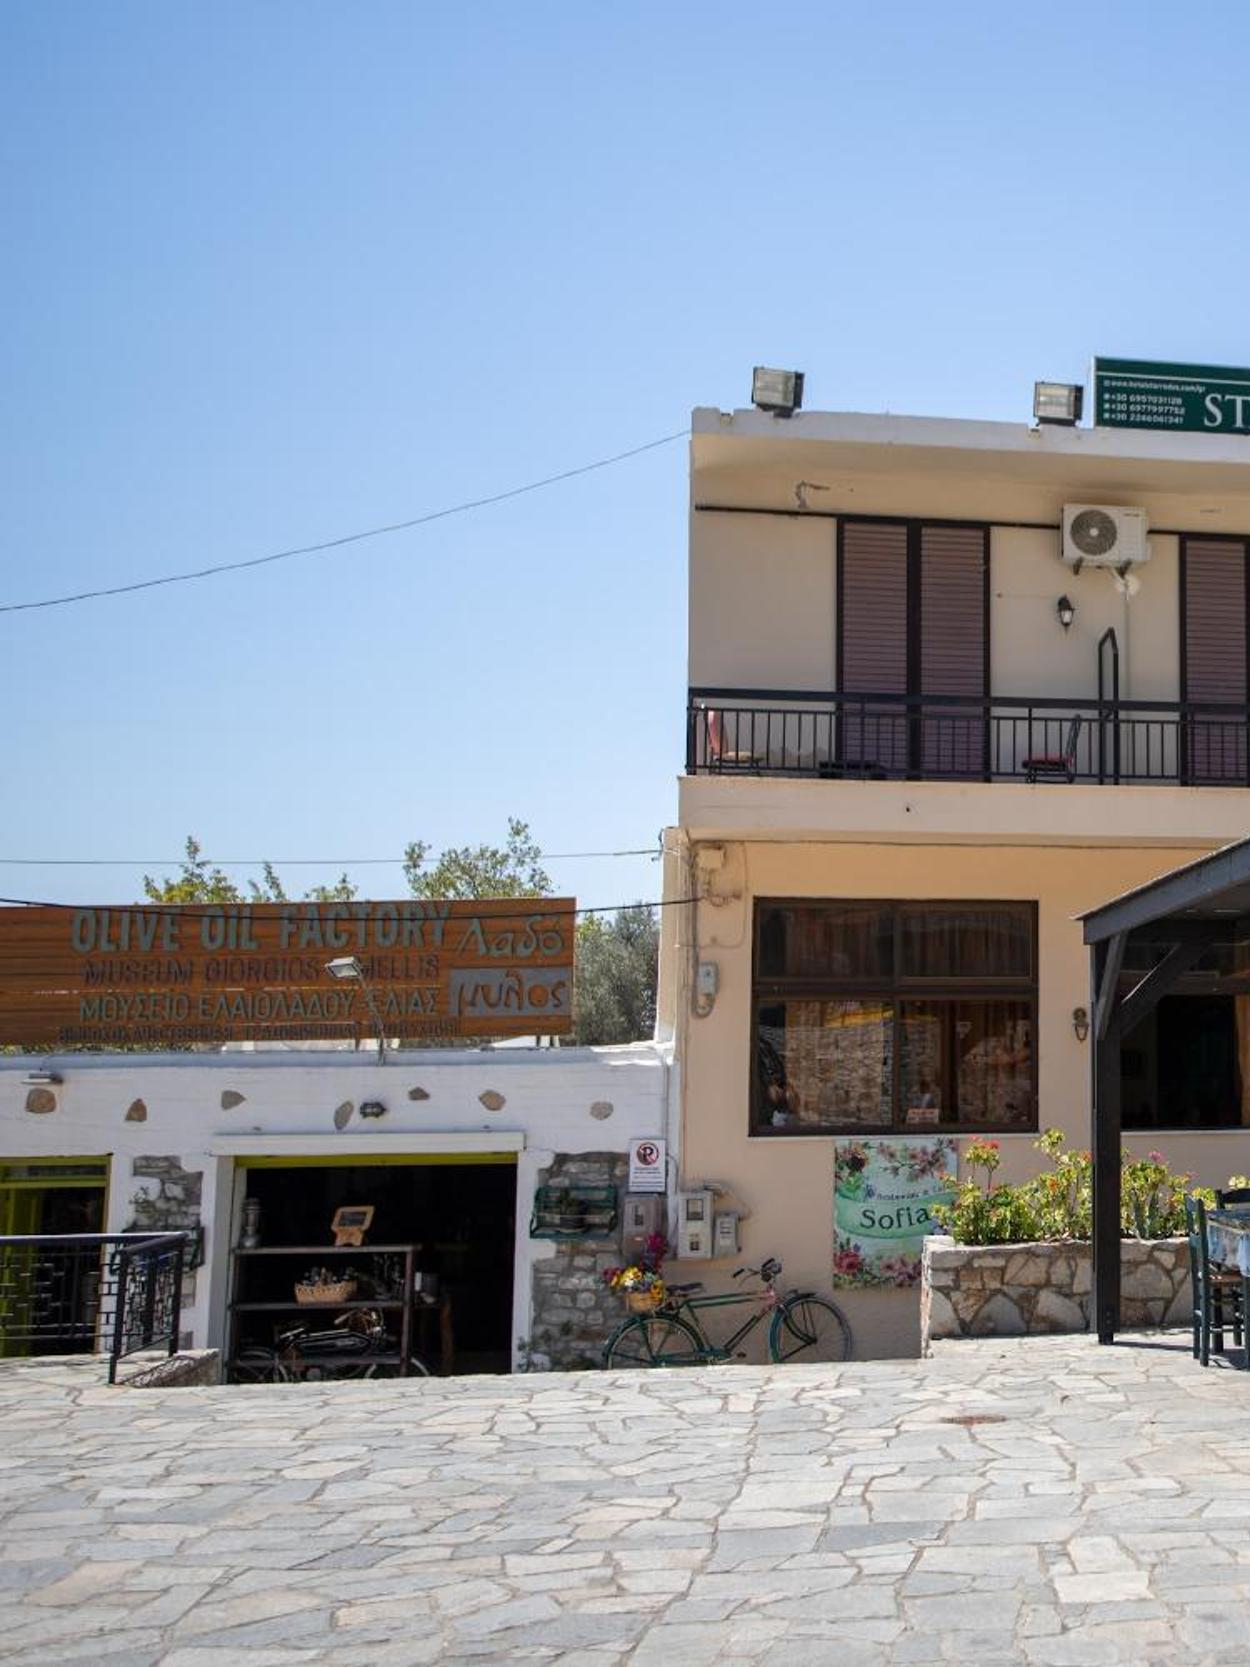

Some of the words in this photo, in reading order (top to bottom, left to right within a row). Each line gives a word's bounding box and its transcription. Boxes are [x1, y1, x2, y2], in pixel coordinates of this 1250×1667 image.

[71, 906, 181, 953] OLIVE
[201, 904, 258, 951] OIL
[279, 901, 450, 950] FACTORY
[79, 992, 191, 1022] ΜΟΥΣΕΙΟ
[859, 1206, 932, 1231] Sofia
